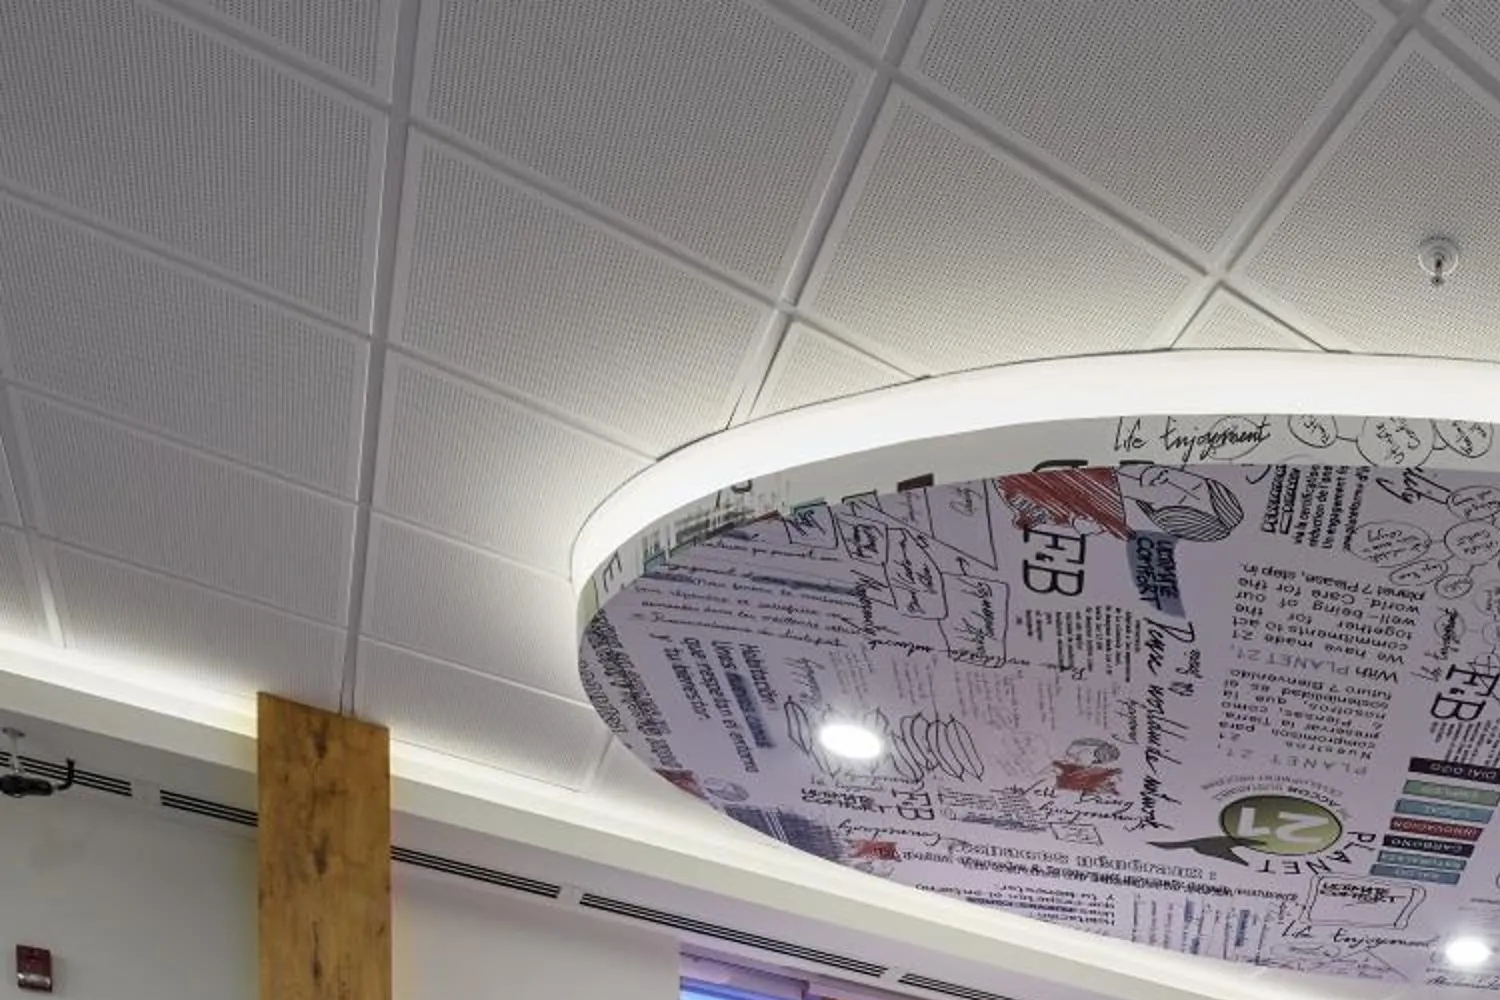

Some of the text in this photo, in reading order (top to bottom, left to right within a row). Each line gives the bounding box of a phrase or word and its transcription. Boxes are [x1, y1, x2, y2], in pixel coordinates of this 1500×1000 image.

[1262, 566, 1296, 580] step
[1238, 578, 1268, 590] the
[1276, 584, 1301, 596] for
[1235, 591, 1266, 603] our
[1311, 590, 1355, 605] Care
[1232, 616, 1260, 628] act
[1235, 604, 1412, 640] together for the
[1264, 634, 1312, 649] made
[1324, 644, 1366, 658] have
[1266, 654, 1349, 675] PLANET
[1355, 667, 1398, 684] With
[1238, 808, 1329, 841] 21
[1255, 831, 1376, 875] PLANET
